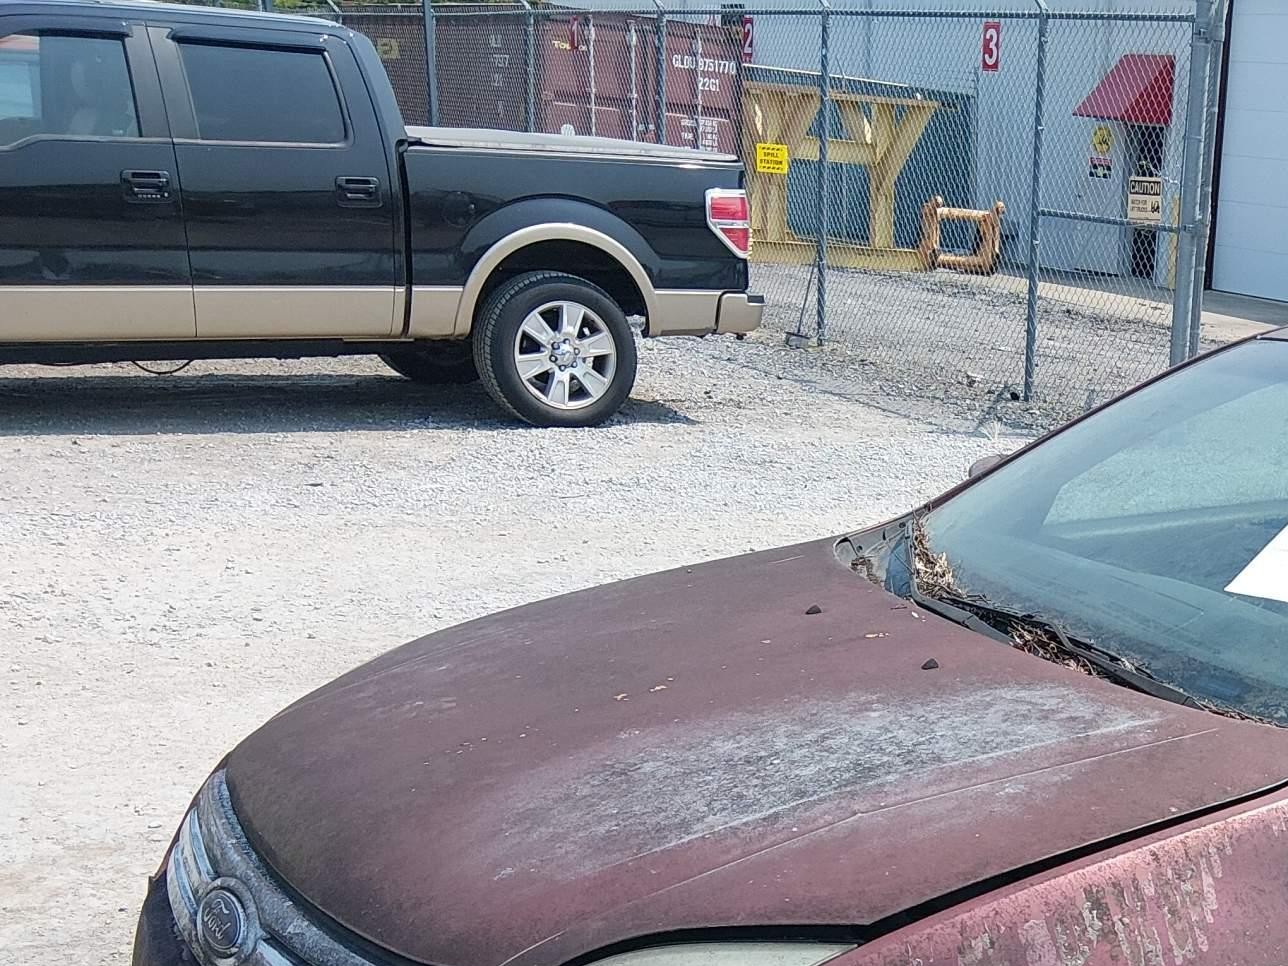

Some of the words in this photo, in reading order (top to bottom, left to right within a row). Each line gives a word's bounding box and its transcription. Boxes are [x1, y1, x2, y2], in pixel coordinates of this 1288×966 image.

[743, 23, 752, 54] 2
[984, 28, 998, 66] 3
[759, 158, 783, 166] STATION
[1130, 181, 1160, 195] CAUTION
[203, 898, 232, 940] Ford
